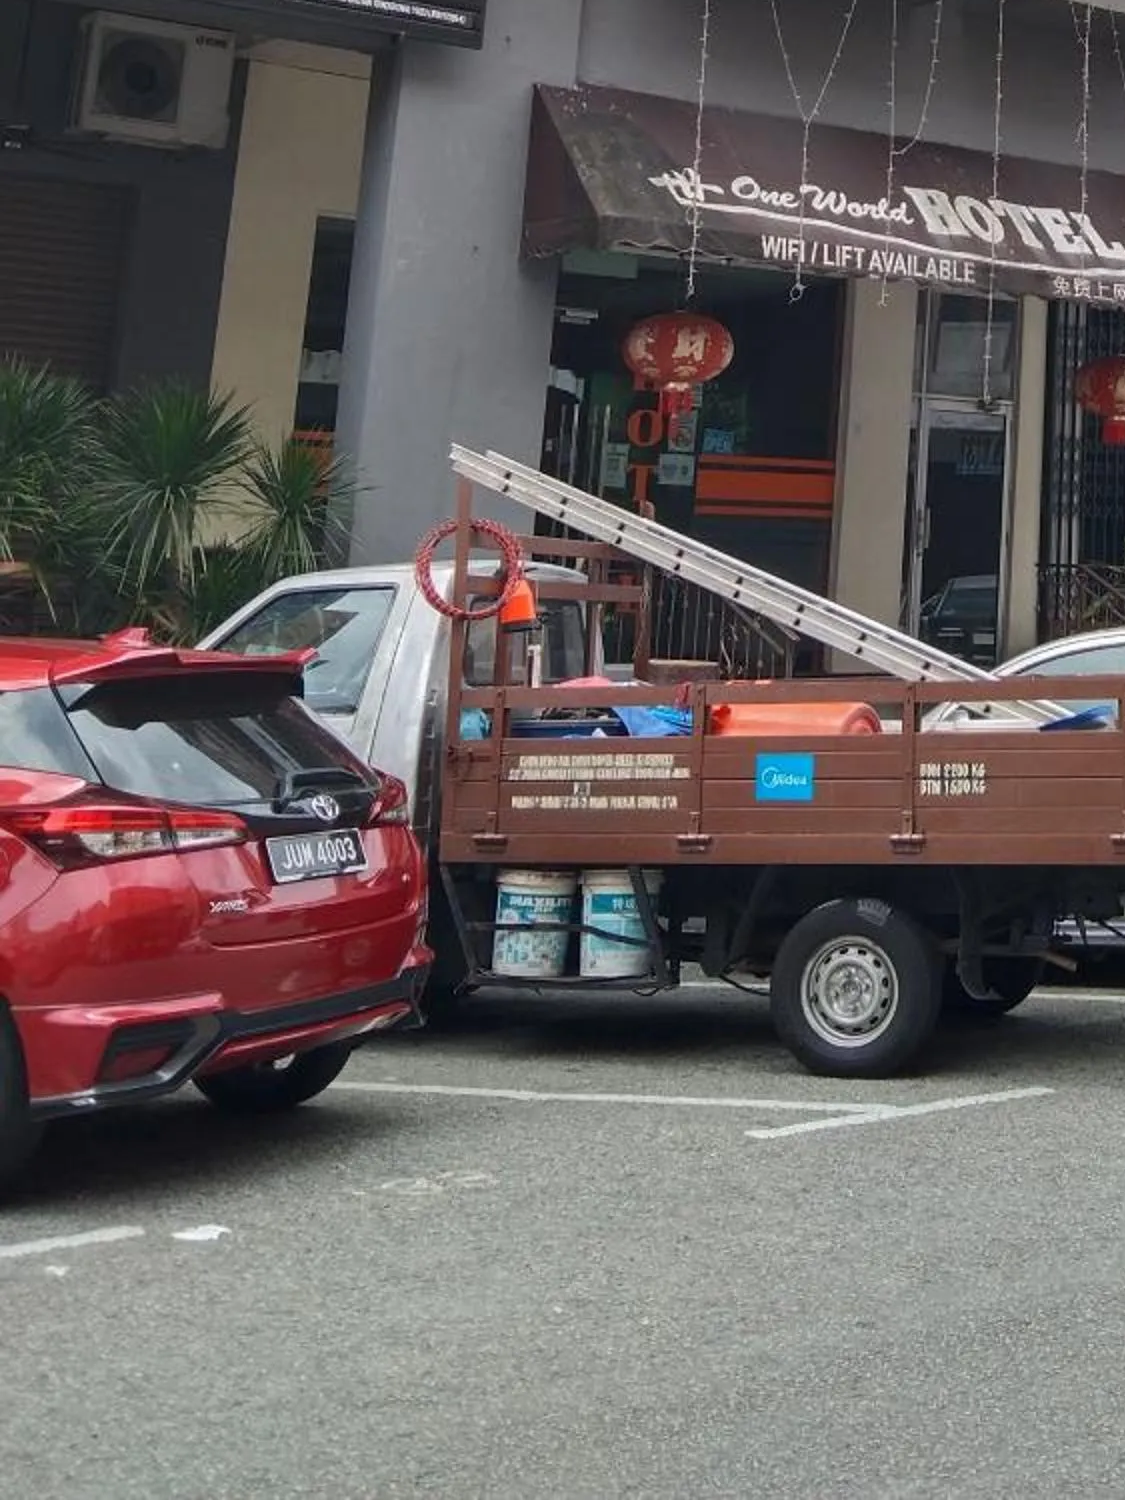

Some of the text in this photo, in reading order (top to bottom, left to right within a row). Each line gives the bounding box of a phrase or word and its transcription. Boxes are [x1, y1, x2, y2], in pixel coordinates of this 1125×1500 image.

[731, 176, 799, 208] One
[799, 184, 914, 225] World
[761, 234, 804, 264] WIFI
[823, 243, 865, 270] LIFT
[868, 252, 976, 284] AVAILABLE
[767, 768, 807, 788] Midea
[283, 837, 357, 869] JUM 4003
